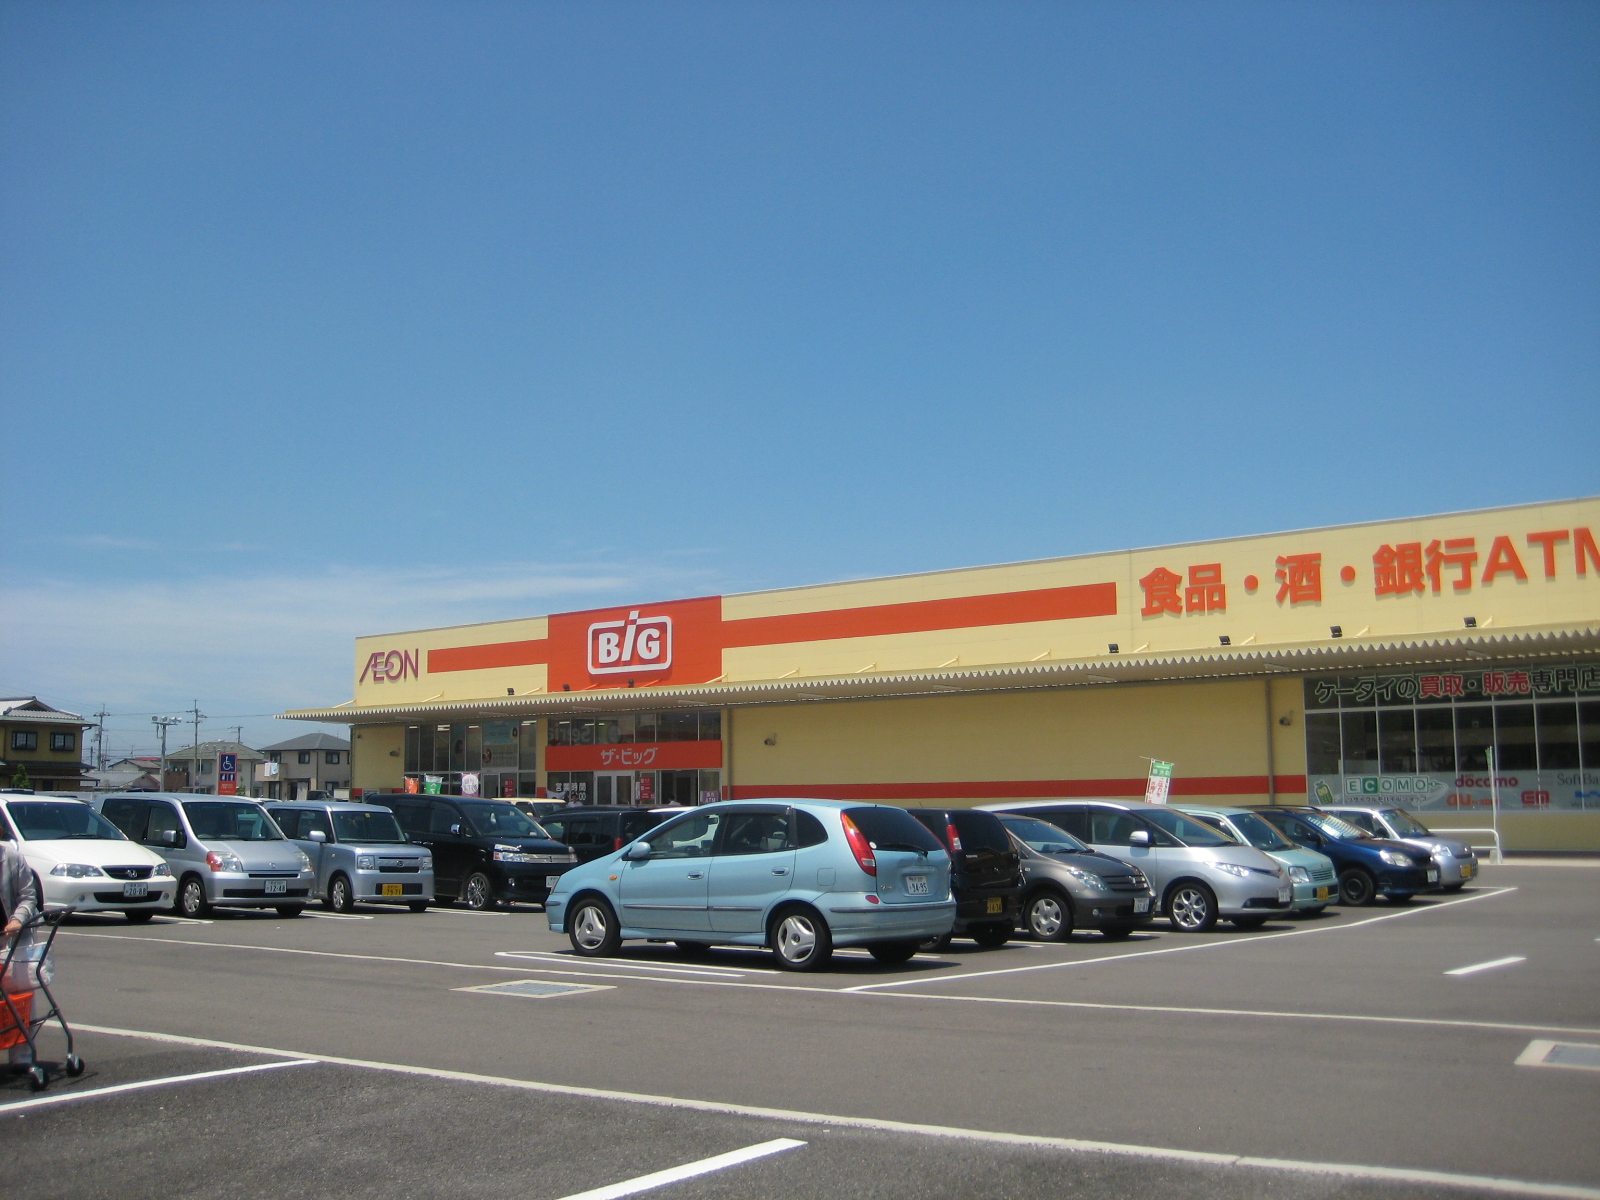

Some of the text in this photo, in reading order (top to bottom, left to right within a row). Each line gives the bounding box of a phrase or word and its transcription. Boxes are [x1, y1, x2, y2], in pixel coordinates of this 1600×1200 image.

[601, 747, 659, 766] ザ・ビッグ
[1348, 779, 1427, 792] ECOMO
